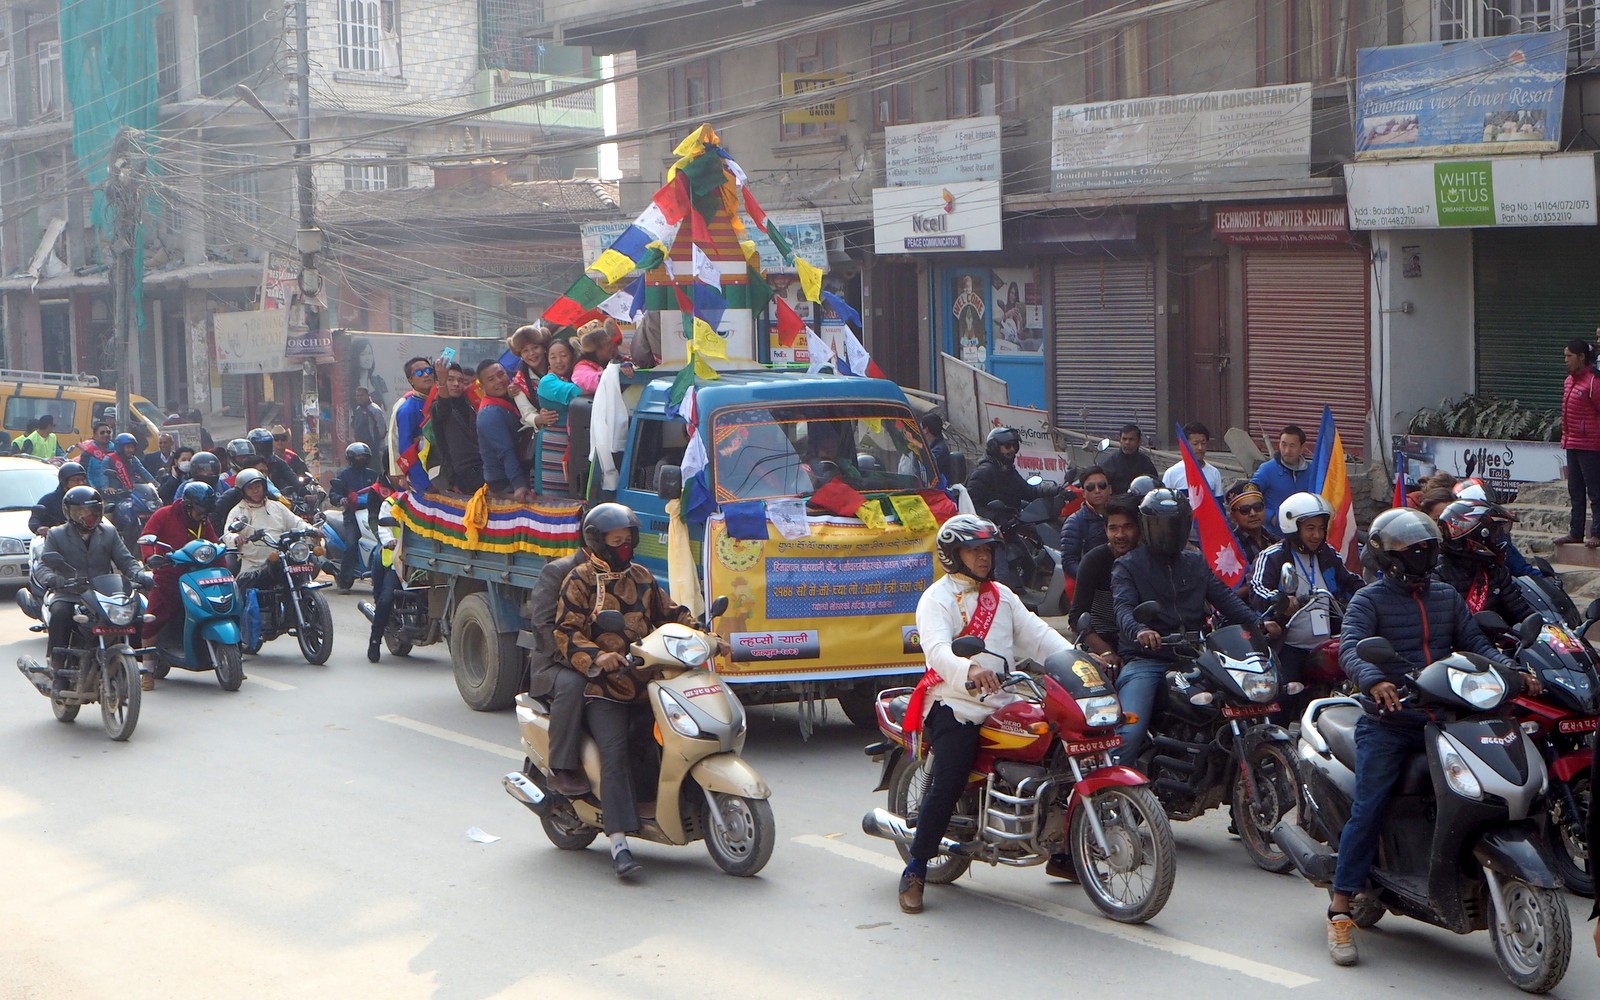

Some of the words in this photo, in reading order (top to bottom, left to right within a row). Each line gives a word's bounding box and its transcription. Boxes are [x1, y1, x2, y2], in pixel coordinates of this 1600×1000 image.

[1083, 105, 1108, 121] TAKE
[1110, 103, 1124, 119] ME
[1127, 101, 1156, 118] AWAY
[1158, 95, 1219, 115] EDUCATION
[1221, 87, 1302, 109] CONSULTANCY
[1362, 98, 1423, 115] Panorama
[1430, 95, 1459, 110] view
[1462, 89, 1507, 108] Tower
[1509, 86, 1554, 107] Resort
[959, 142, 968, 151] Fax
[1101, 168, 1137, 178] Branch
[1439, 171, 1487, 187] WHITE
[1440, 187, 1488, 203] LOTUS
[1354, 207, 1369, 216] Add
[1373, 206, 1405, 216] Bouddha,
[1407, 205, 1424, 214] Tusal
[1466, 205, 1489, 213] CONCERN
[1501, 203, 1516, 213] Reg
[1517, 202, 1528, 211] No
[1533, 200, 1590, 211] 141164/072/073
[912, 213, 946, 232] Ncell
[1216, 210, 1260, 229] TECHNOBITE
[1263, 209, 1303, 227] COMPUTER
[1306, 207, 1345, 226] SOLUTION
[1355, 217, 1377, 226] Phone
[1381, 216, 1416, 226] 014482710
[1502, 214, 1516, 223] Pan
[1517, 213, 1528, 222] No
[1533, 212, 1572, 222] 603552119
[907, 239, 922, 248] PEACE
[922, 237, 959, 248] COMMUNICATION
[952, 292, 985, 317] WELCOME
[287, 337, 331, 348] ORCHID
[773, 350, 787, 358] FedEx
[1463, 446, 1501, 474] Coffee
[1003, 719, 1022, 728] HERO
[1001, 724, 1025, 735] HONDA
